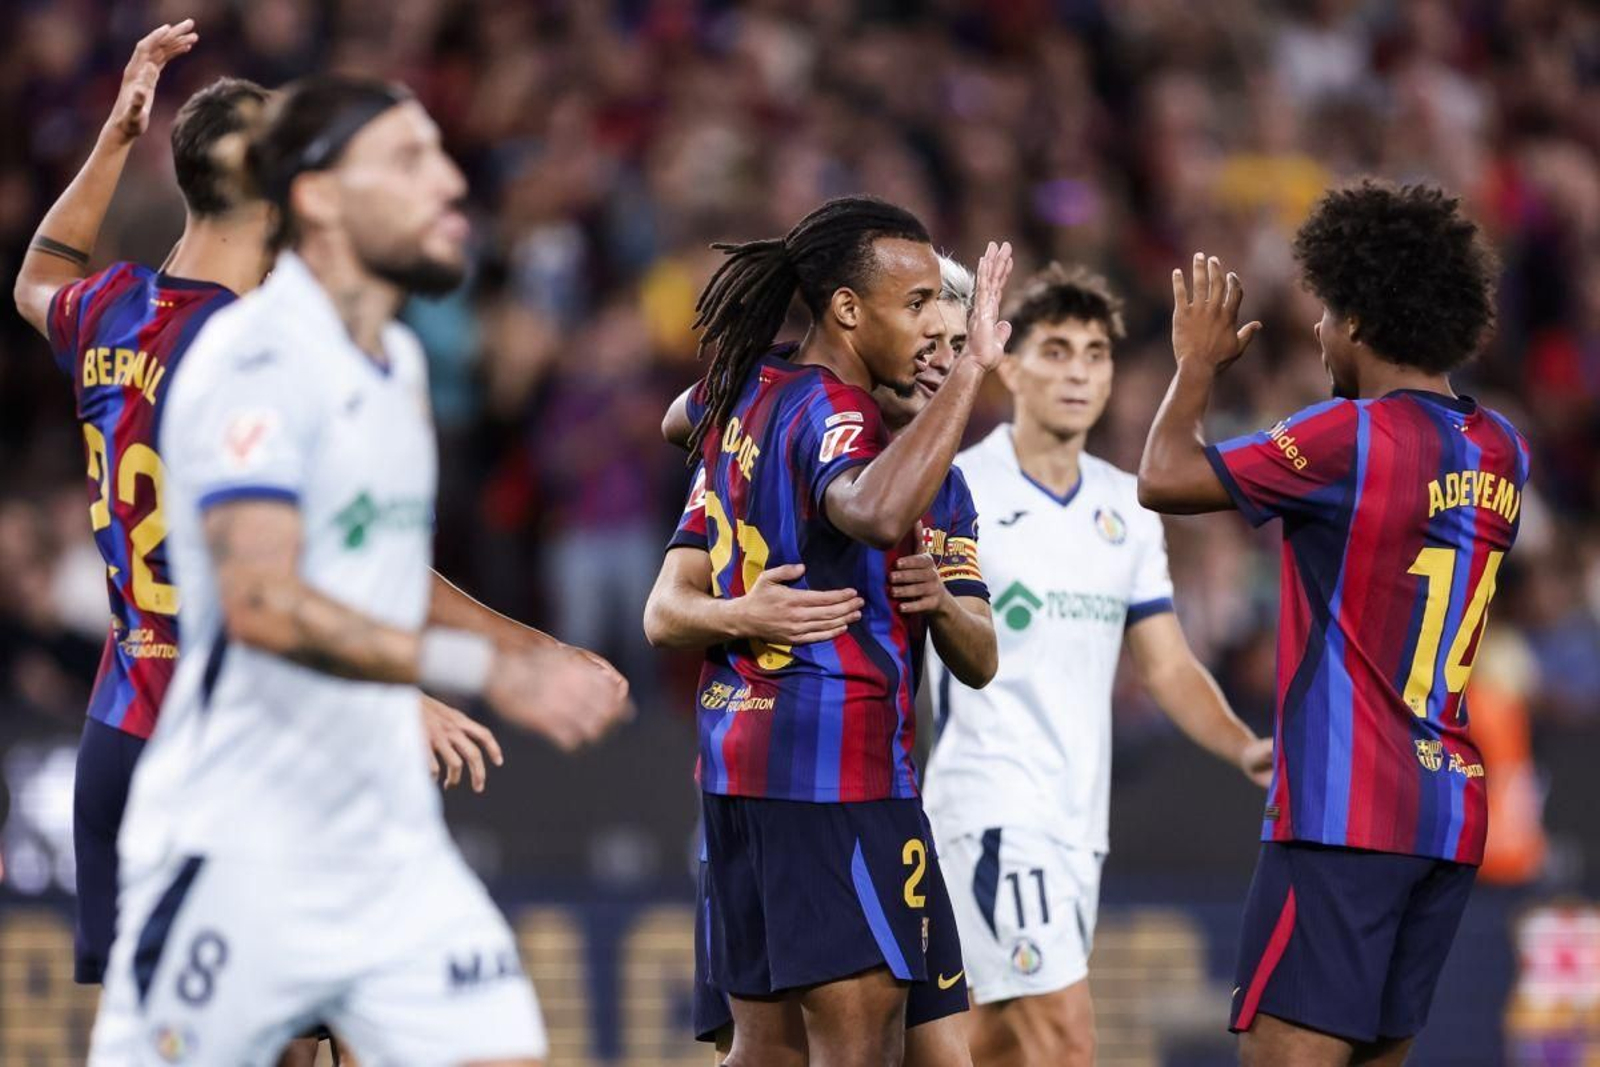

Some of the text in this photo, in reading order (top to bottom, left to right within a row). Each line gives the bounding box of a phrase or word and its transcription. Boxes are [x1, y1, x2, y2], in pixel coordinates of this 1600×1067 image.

[83, 346, 166, 405] BERNL
[1428, 470, 1521, 524] ADEYEMI
[1404, 548, 1504, 719] 14
[902, 838, 928, 908] 2
[1003, 868, 1049, 929] 11
[177, 930, 228, 1007] 8
